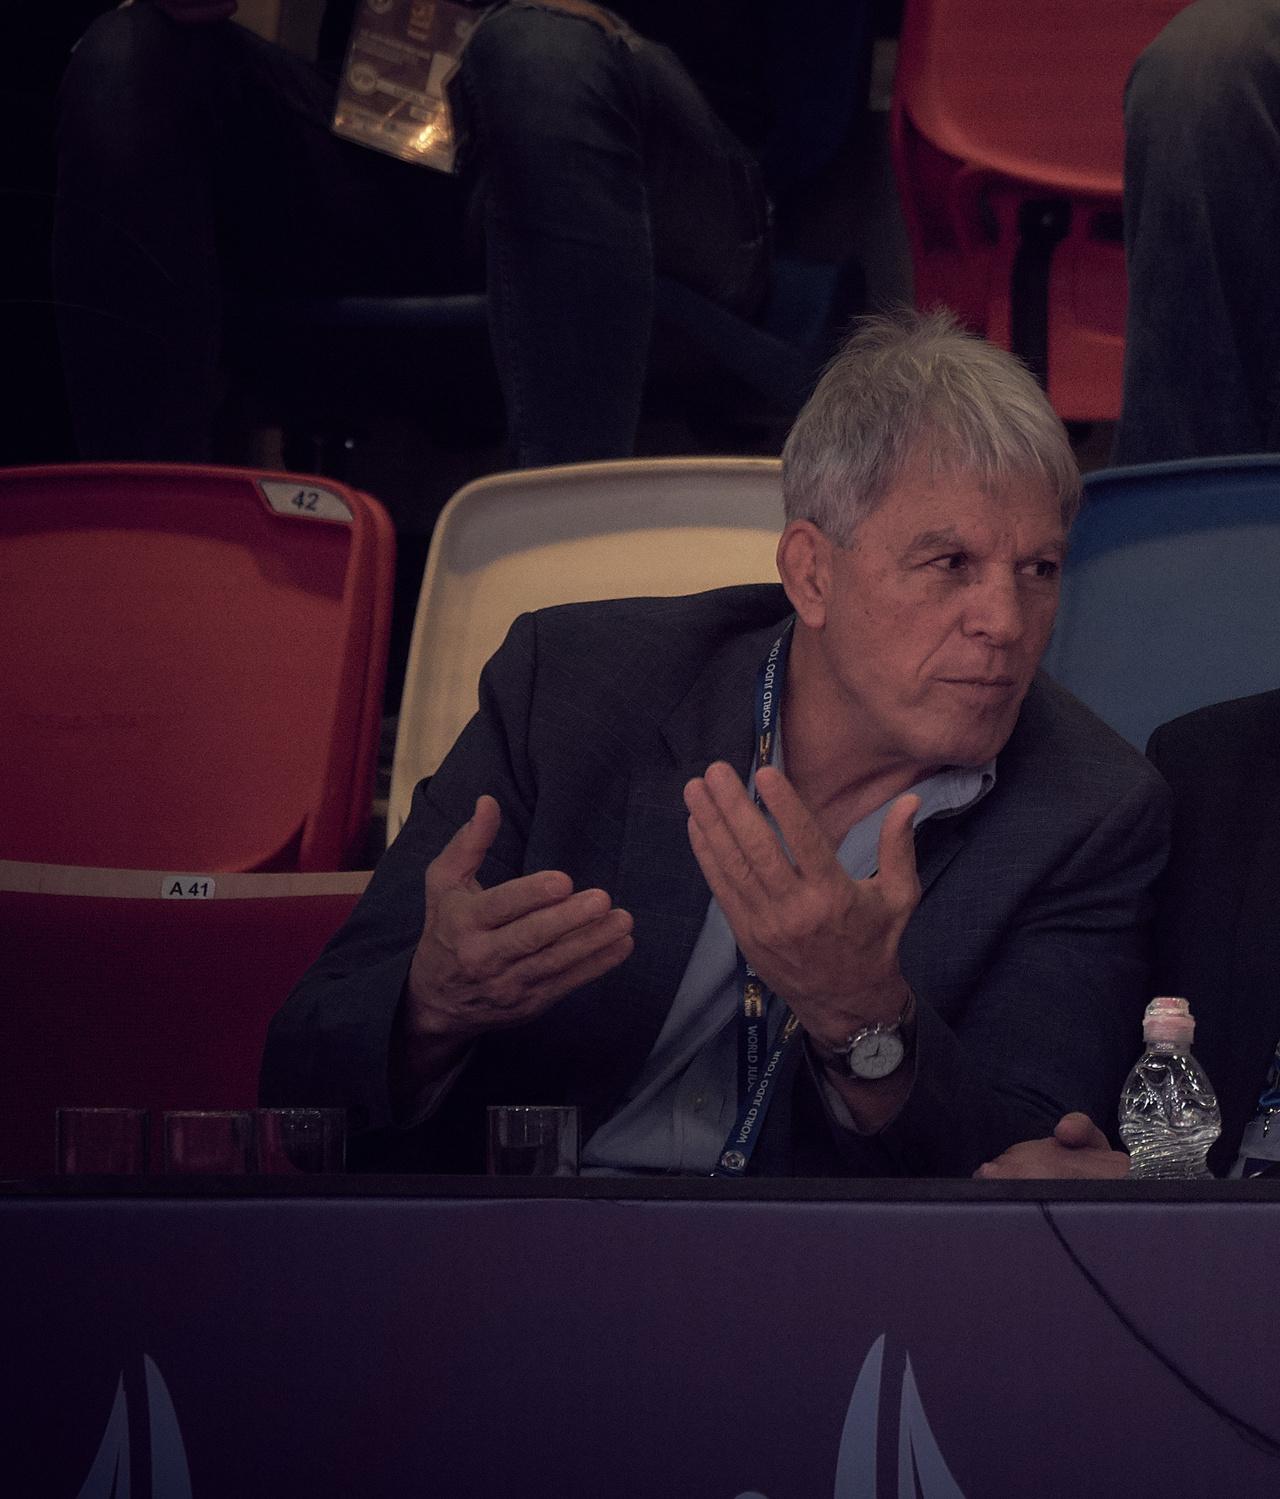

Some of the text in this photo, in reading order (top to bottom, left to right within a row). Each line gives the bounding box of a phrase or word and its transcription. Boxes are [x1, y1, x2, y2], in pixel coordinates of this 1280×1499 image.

[291, 491, 319, 511] 42
[764, 663, 776, 689] JUDO
[762, 691, 773, 730] WORLD
[169, 881, 208, 897] A 41
[747, 1025, 758, 1062] WORLD
[736, 1050, 782, 1143] WORLD JUDO TOUR
